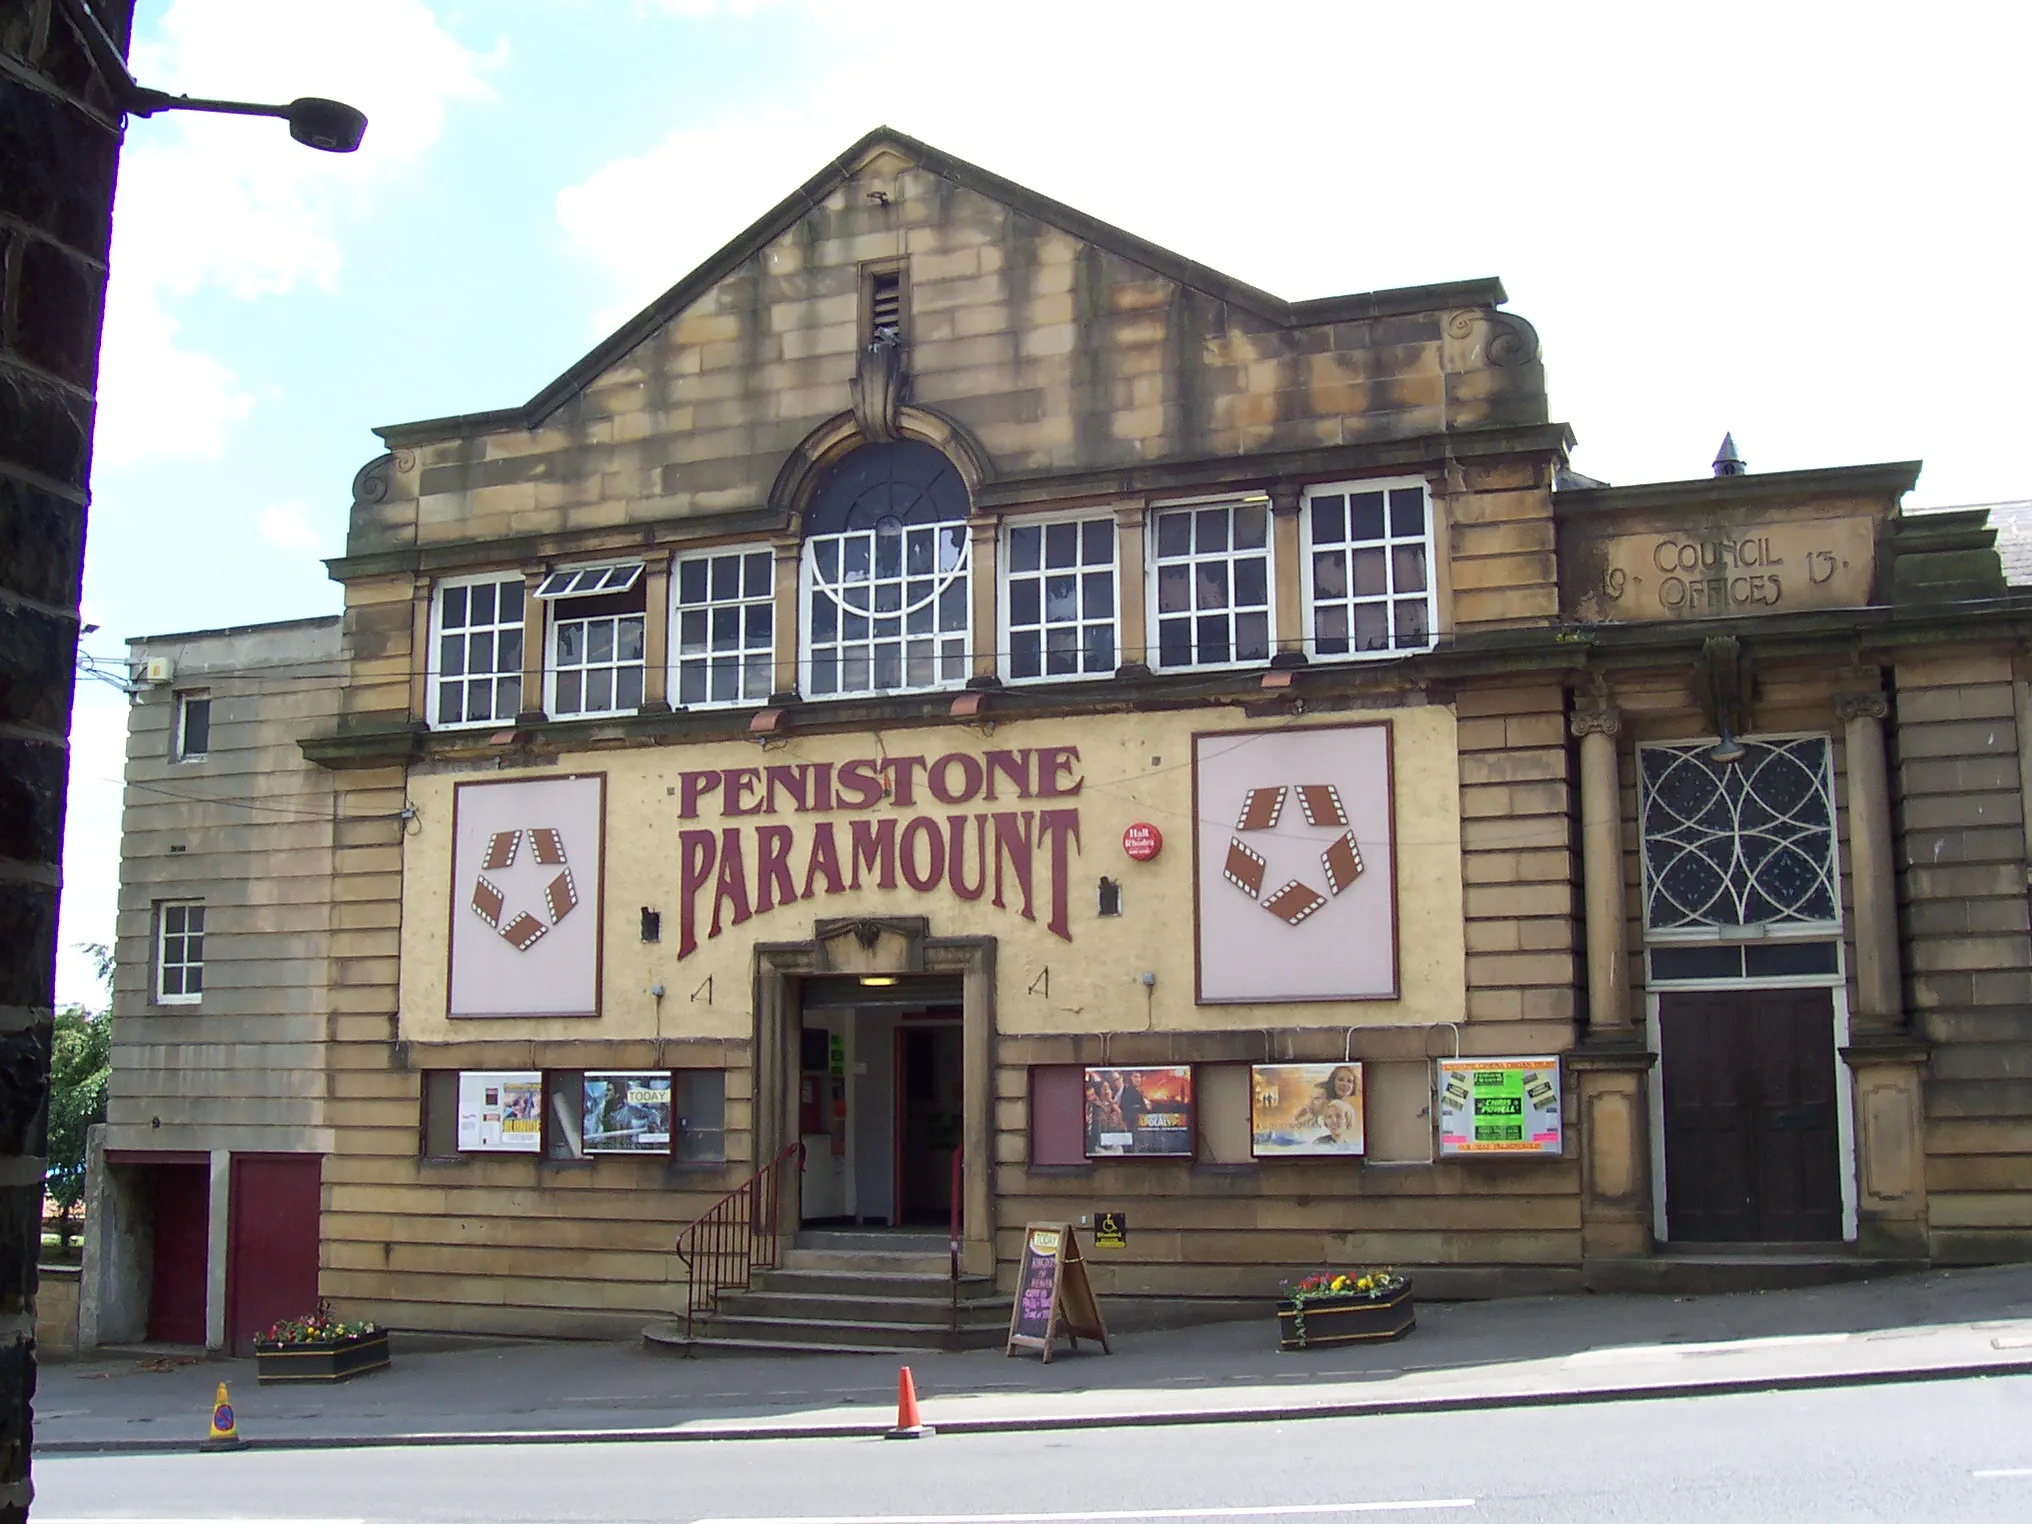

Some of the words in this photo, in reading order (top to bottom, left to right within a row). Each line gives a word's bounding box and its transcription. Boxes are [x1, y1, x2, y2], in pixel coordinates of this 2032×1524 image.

[1653, 537, 1784, 574] COUNCIL
[1659, 574, 1783, 609] OFFICES
[677, 746, 1085, 818] PENISTONE
[677, 808, 1081, 961] PARAMOUNT
[629, 1091, 666, 1102] TODAY
[1036, 1232, 1057, 1245] TODAY
